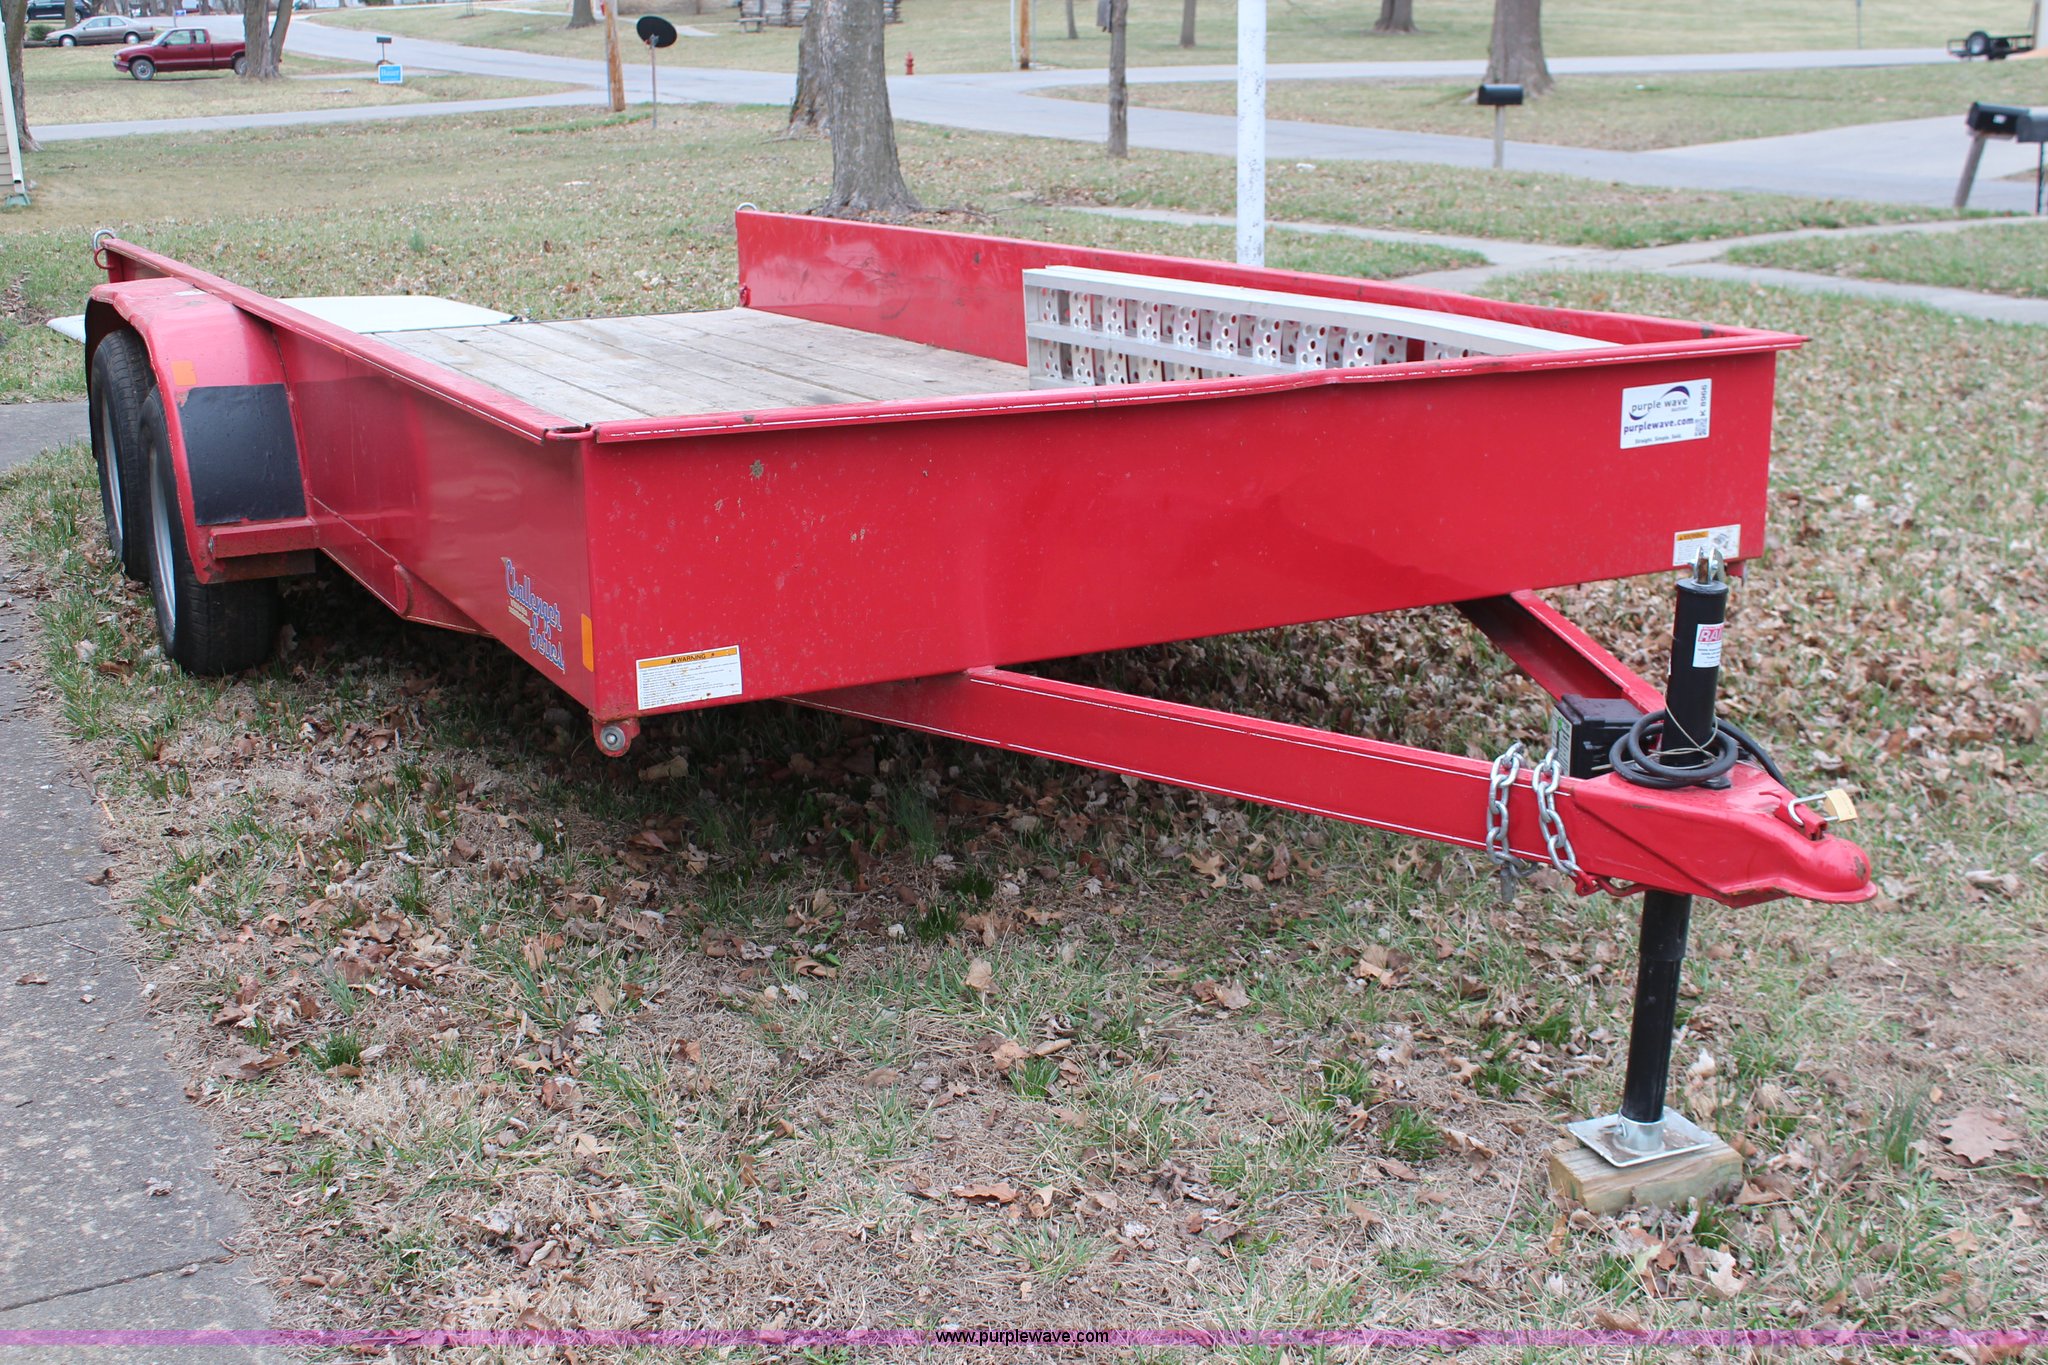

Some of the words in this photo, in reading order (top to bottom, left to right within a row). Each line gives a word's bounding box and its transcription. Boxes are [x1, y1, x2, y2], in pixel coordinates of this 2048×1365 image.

[1631, 400, 1661, 413] purple
[1664, 398, 1688, 408] wave
[1623, 417, 1694, 435] purplewave.com
[676, 653, 706, 663] WARNING
